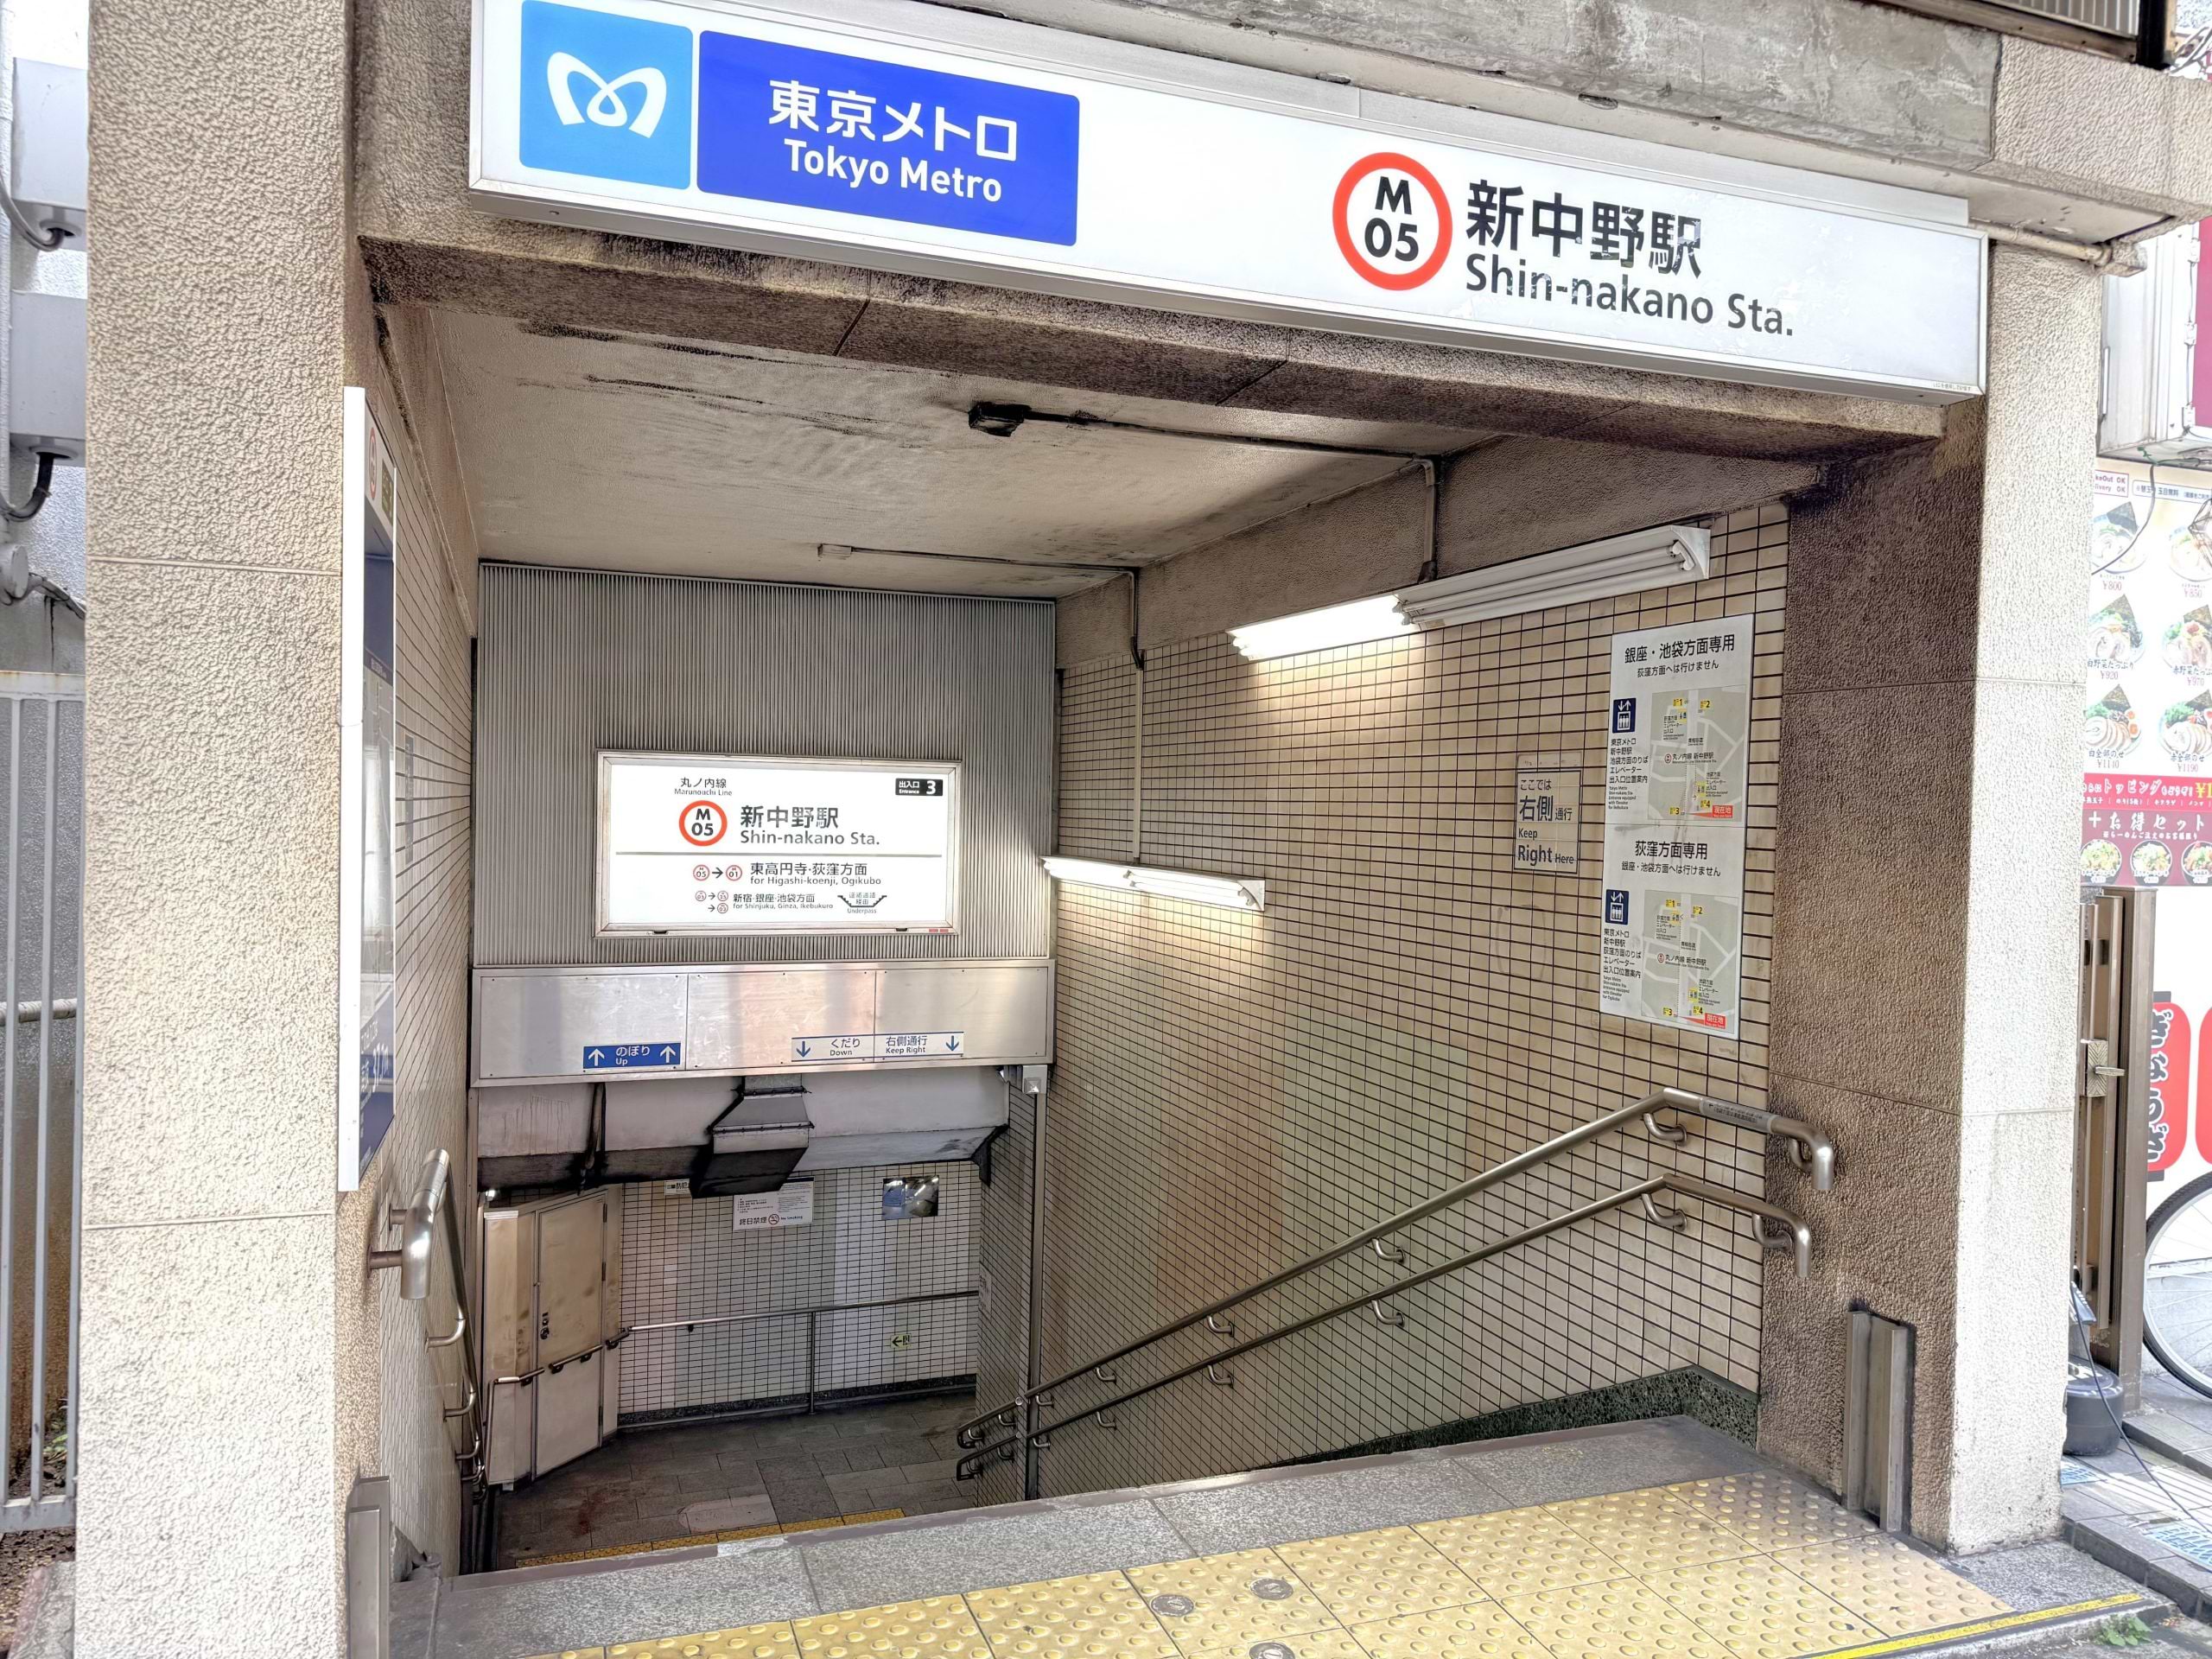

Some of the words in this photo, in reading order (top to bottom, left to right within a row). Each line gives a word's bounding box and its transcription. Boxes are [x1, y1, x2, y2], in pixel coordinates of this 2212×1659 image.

[769, 79, 1017, 162] 東京メトロ
[784, 139, 888, 189] Tokyo
[899, 158, 1002, 202] Metro
[1376, 176, 1412, 214] M
[1466, 179, 1701, 279] 新中野駅
[1363, 218, 1420, 262] 05
[1466, 254, 1713, 327] Shin-nakano
[1728, 293, 1793, 336] Sta.
[1624, 634, 1735, 664] 銀座・池袋方面専用
[1637, 660, 1719, 677] 荻窪方面へは行けません
[681, 777, 726, 788] 丸ノ内線
[926, 780, 936, 794] 3
[1521, 779, 1552, 791] ここでは
[696, 809, 710, 820] M
[741, 805, 838, 828] 新中野駅
[691, 823, 714, 836] 05
[1519, 828, 1537, 840] Keep
[741, 830, 844, 844] Shin-nakano
[851, 832, 880, 845] Sta.
[1518, 845, 1552, 866] Right
[1555, 854, 1573, 864] Here
[1635, 840, 1707, 860] 荻窪方面専用
[750, 862, 868, 876] 東高円寺・荻窪方面
[1622, 861, 1720, 876] 銀座・池袋方面へは行けません
[768, 876, 837, 887] Higashi-koenji,
[842, 877, 880, 886] Ogikubo
[1604, 928, 1629, 938] 東京メトロ
[1604, 938, 1625, 947] 新中野駅
[1604, 957, 1635, 966] エレベーター
[1604, 965, 1641, 978] 出入口位置案内
[831, 1038, 861, 1048] くだり
[887, 1035, 927, 1046] 右側通行
[616, 1046, 650, 1056] のぼり
